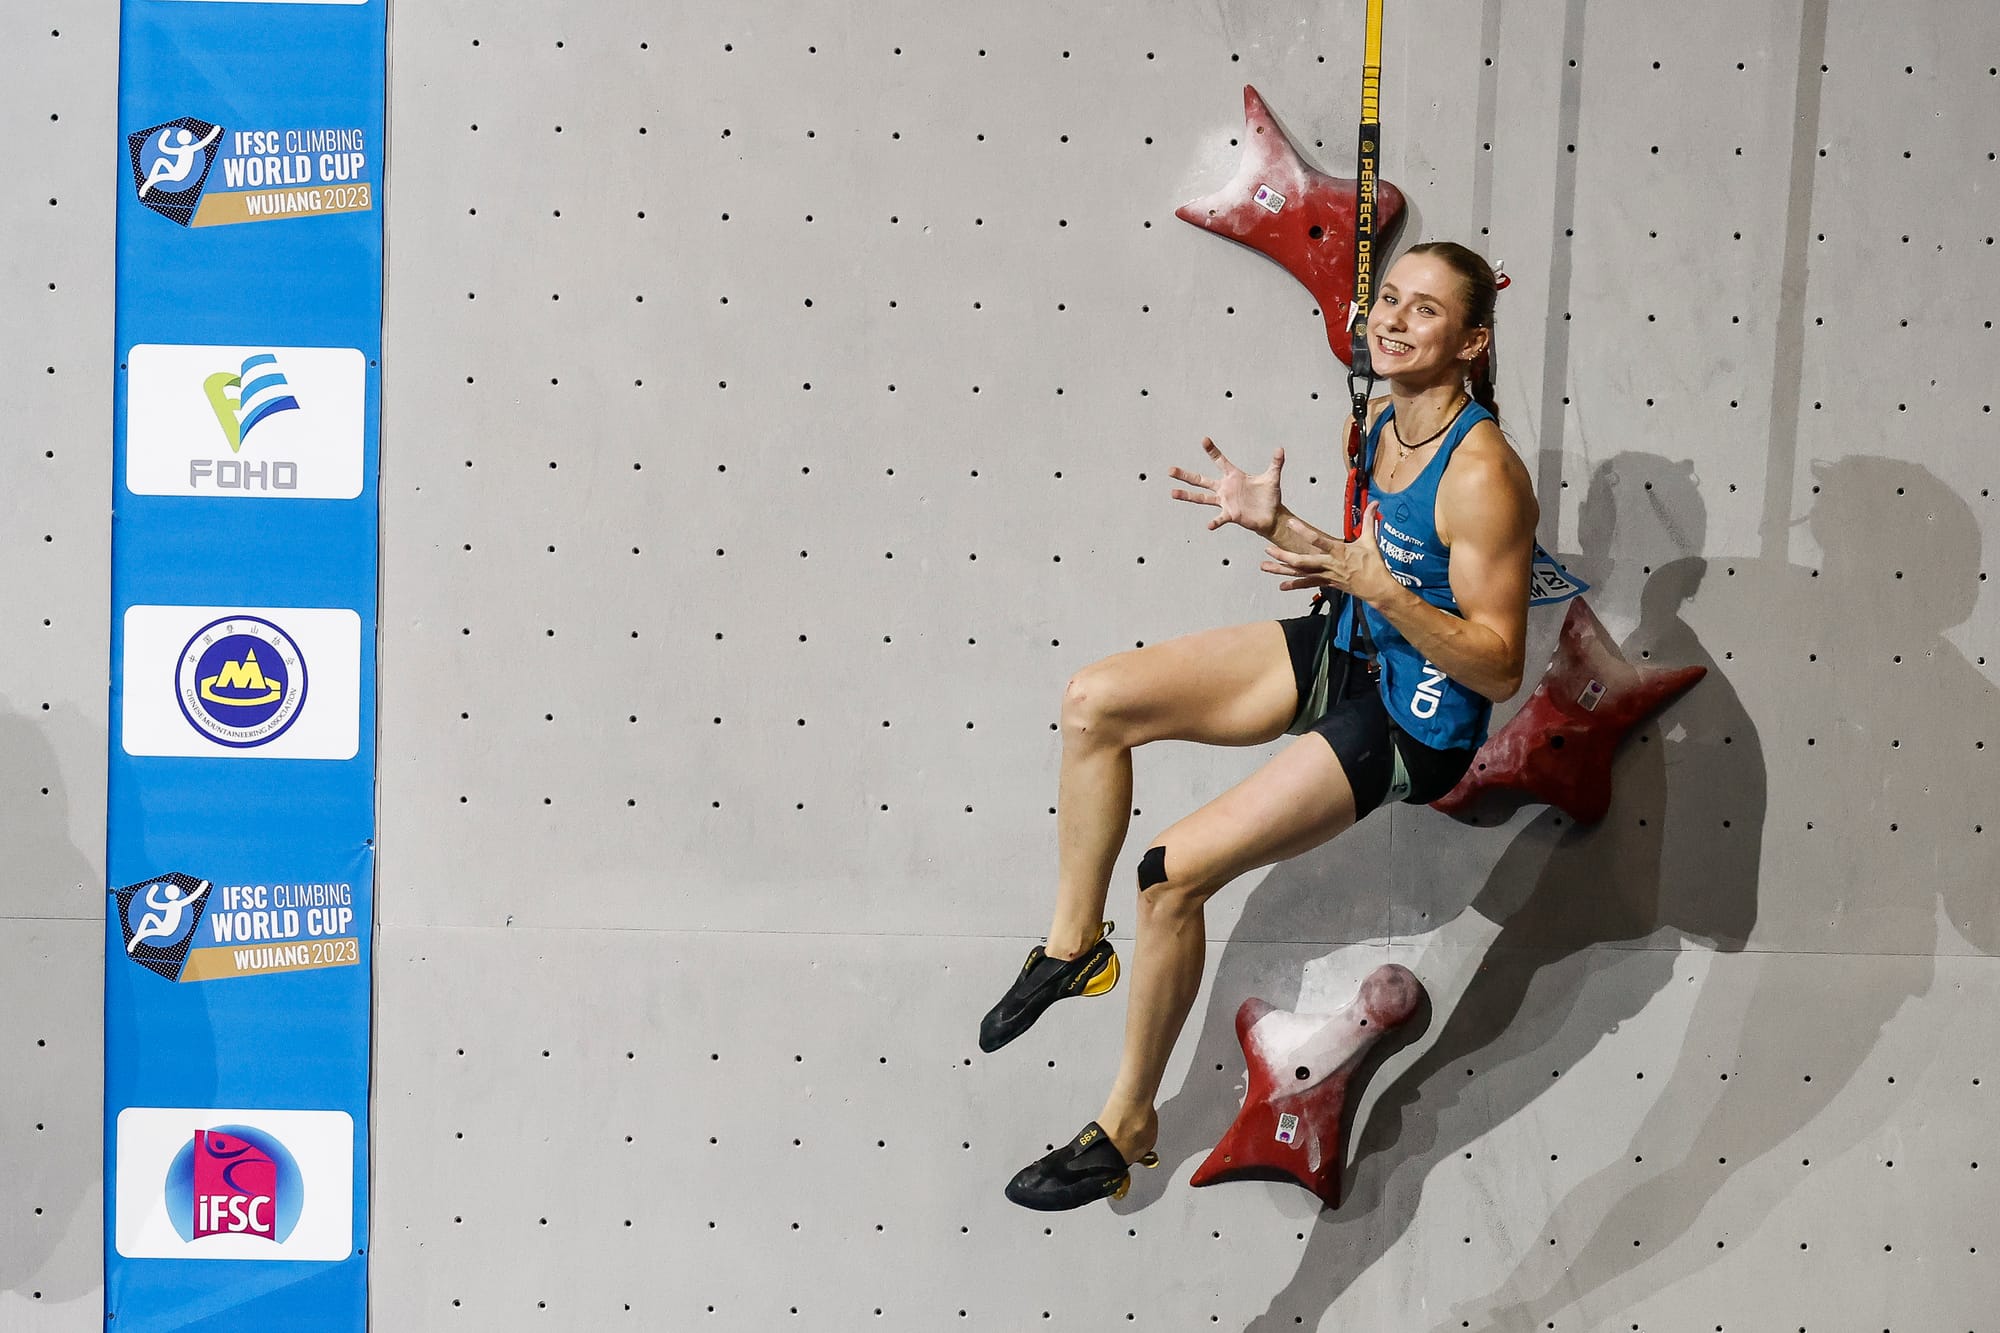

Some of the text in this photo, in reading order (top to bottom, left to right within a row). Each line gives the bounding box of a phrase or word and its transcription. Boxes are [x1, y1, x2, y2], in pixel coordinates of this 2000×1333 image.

[234, 128, 363, 155] IFSC CLIMBING
[223, 152, 365, 188] WORLD CUP
[245, 186, 369, 216] WUJIANG 2023
[1357, 158, 1373, 318] PERFECT DESCENT
[189, 459, 298, 491] FOHO
[186, 687, 297, 738] CHINESE MOUNTAINEERING ASSOCIATION
[223, 883, 351, 911] IFSC CLIMBING
[211, 909, 353, 943] WORLD CUP
[234, 940, 357, 971] WUJIANG 2023
[198, 1194, 271, 1232] iFSC
